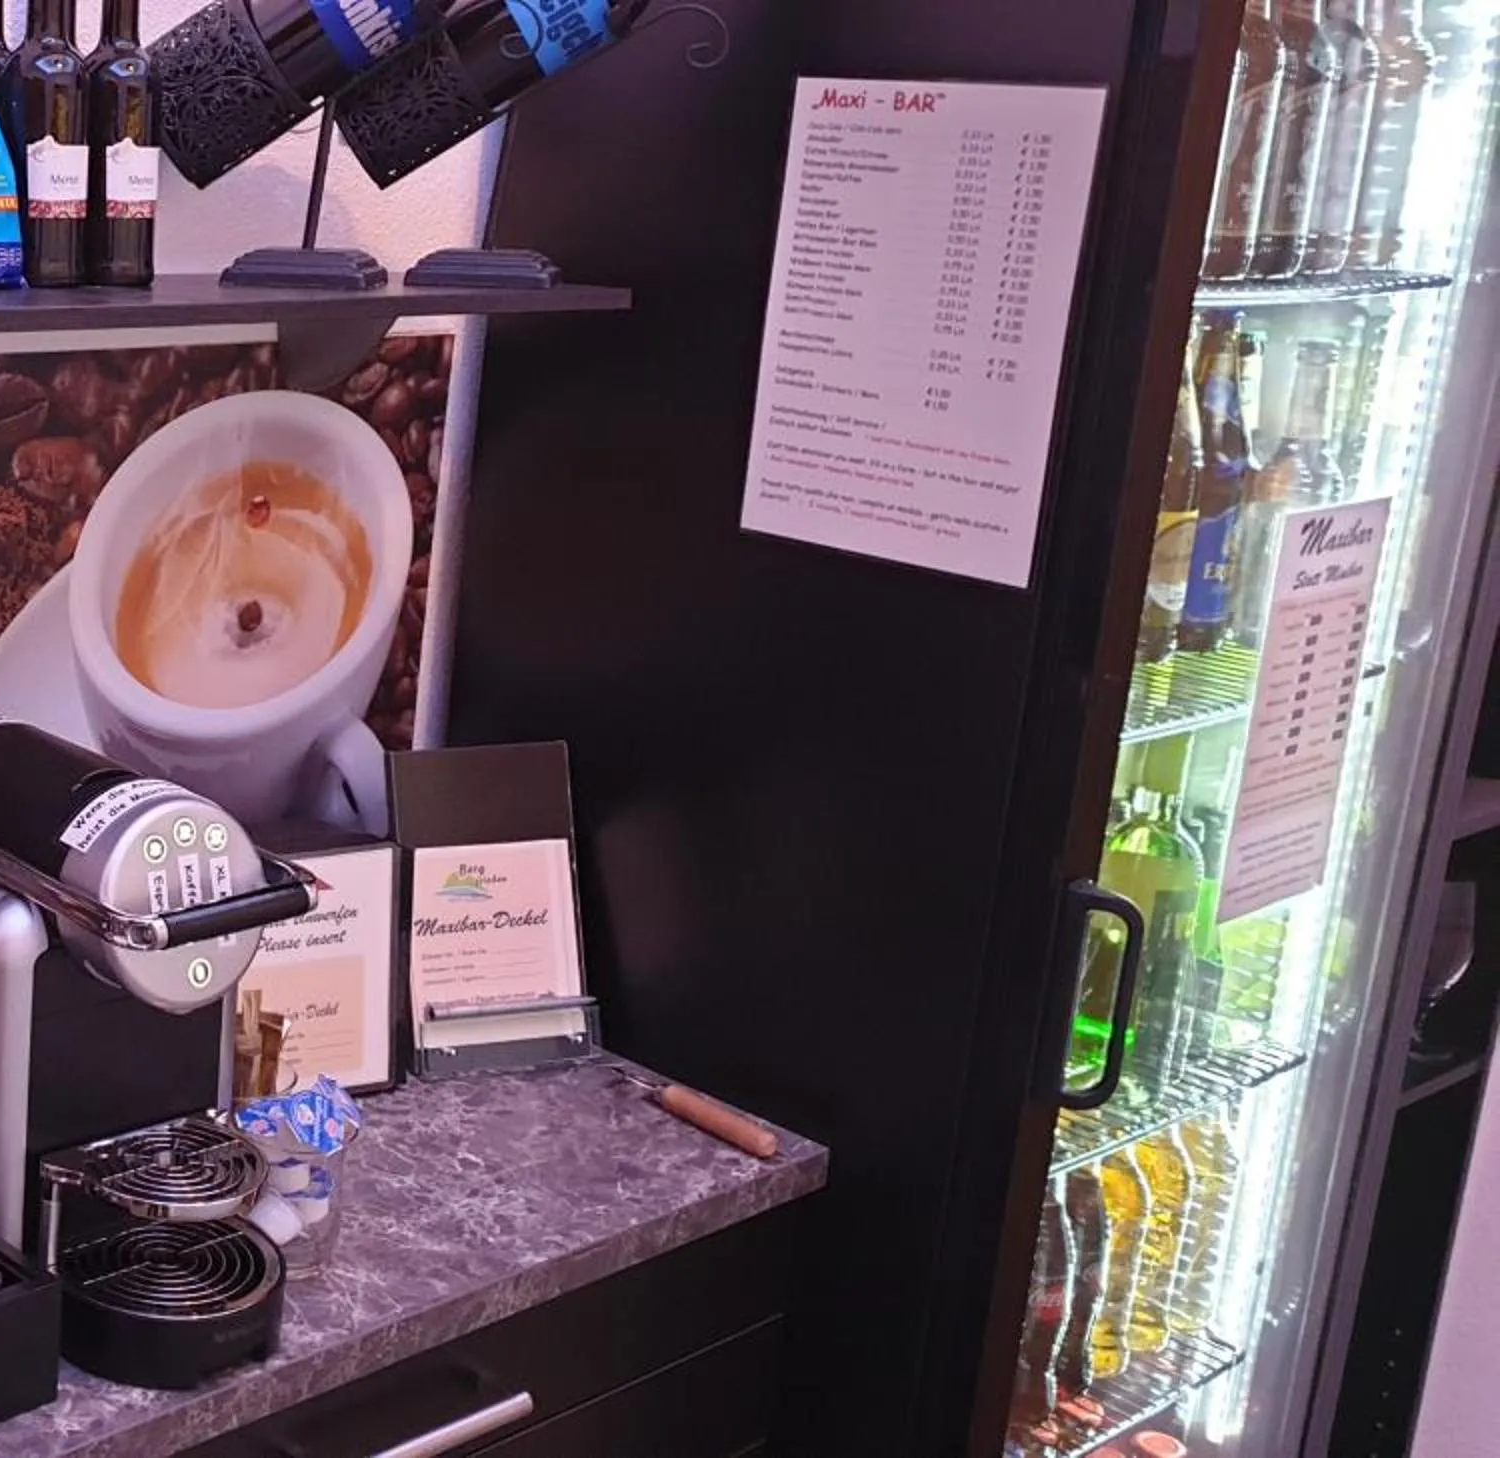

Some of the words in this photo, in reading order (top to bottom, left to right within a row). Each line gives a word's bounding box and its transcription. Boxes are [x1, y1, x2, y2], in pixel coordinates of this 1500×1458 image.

[339, 0, 399, 54] nkis
[305, 929, 347, 947] insert
[413, 908, 549, 938] Maxibar-Deckel
